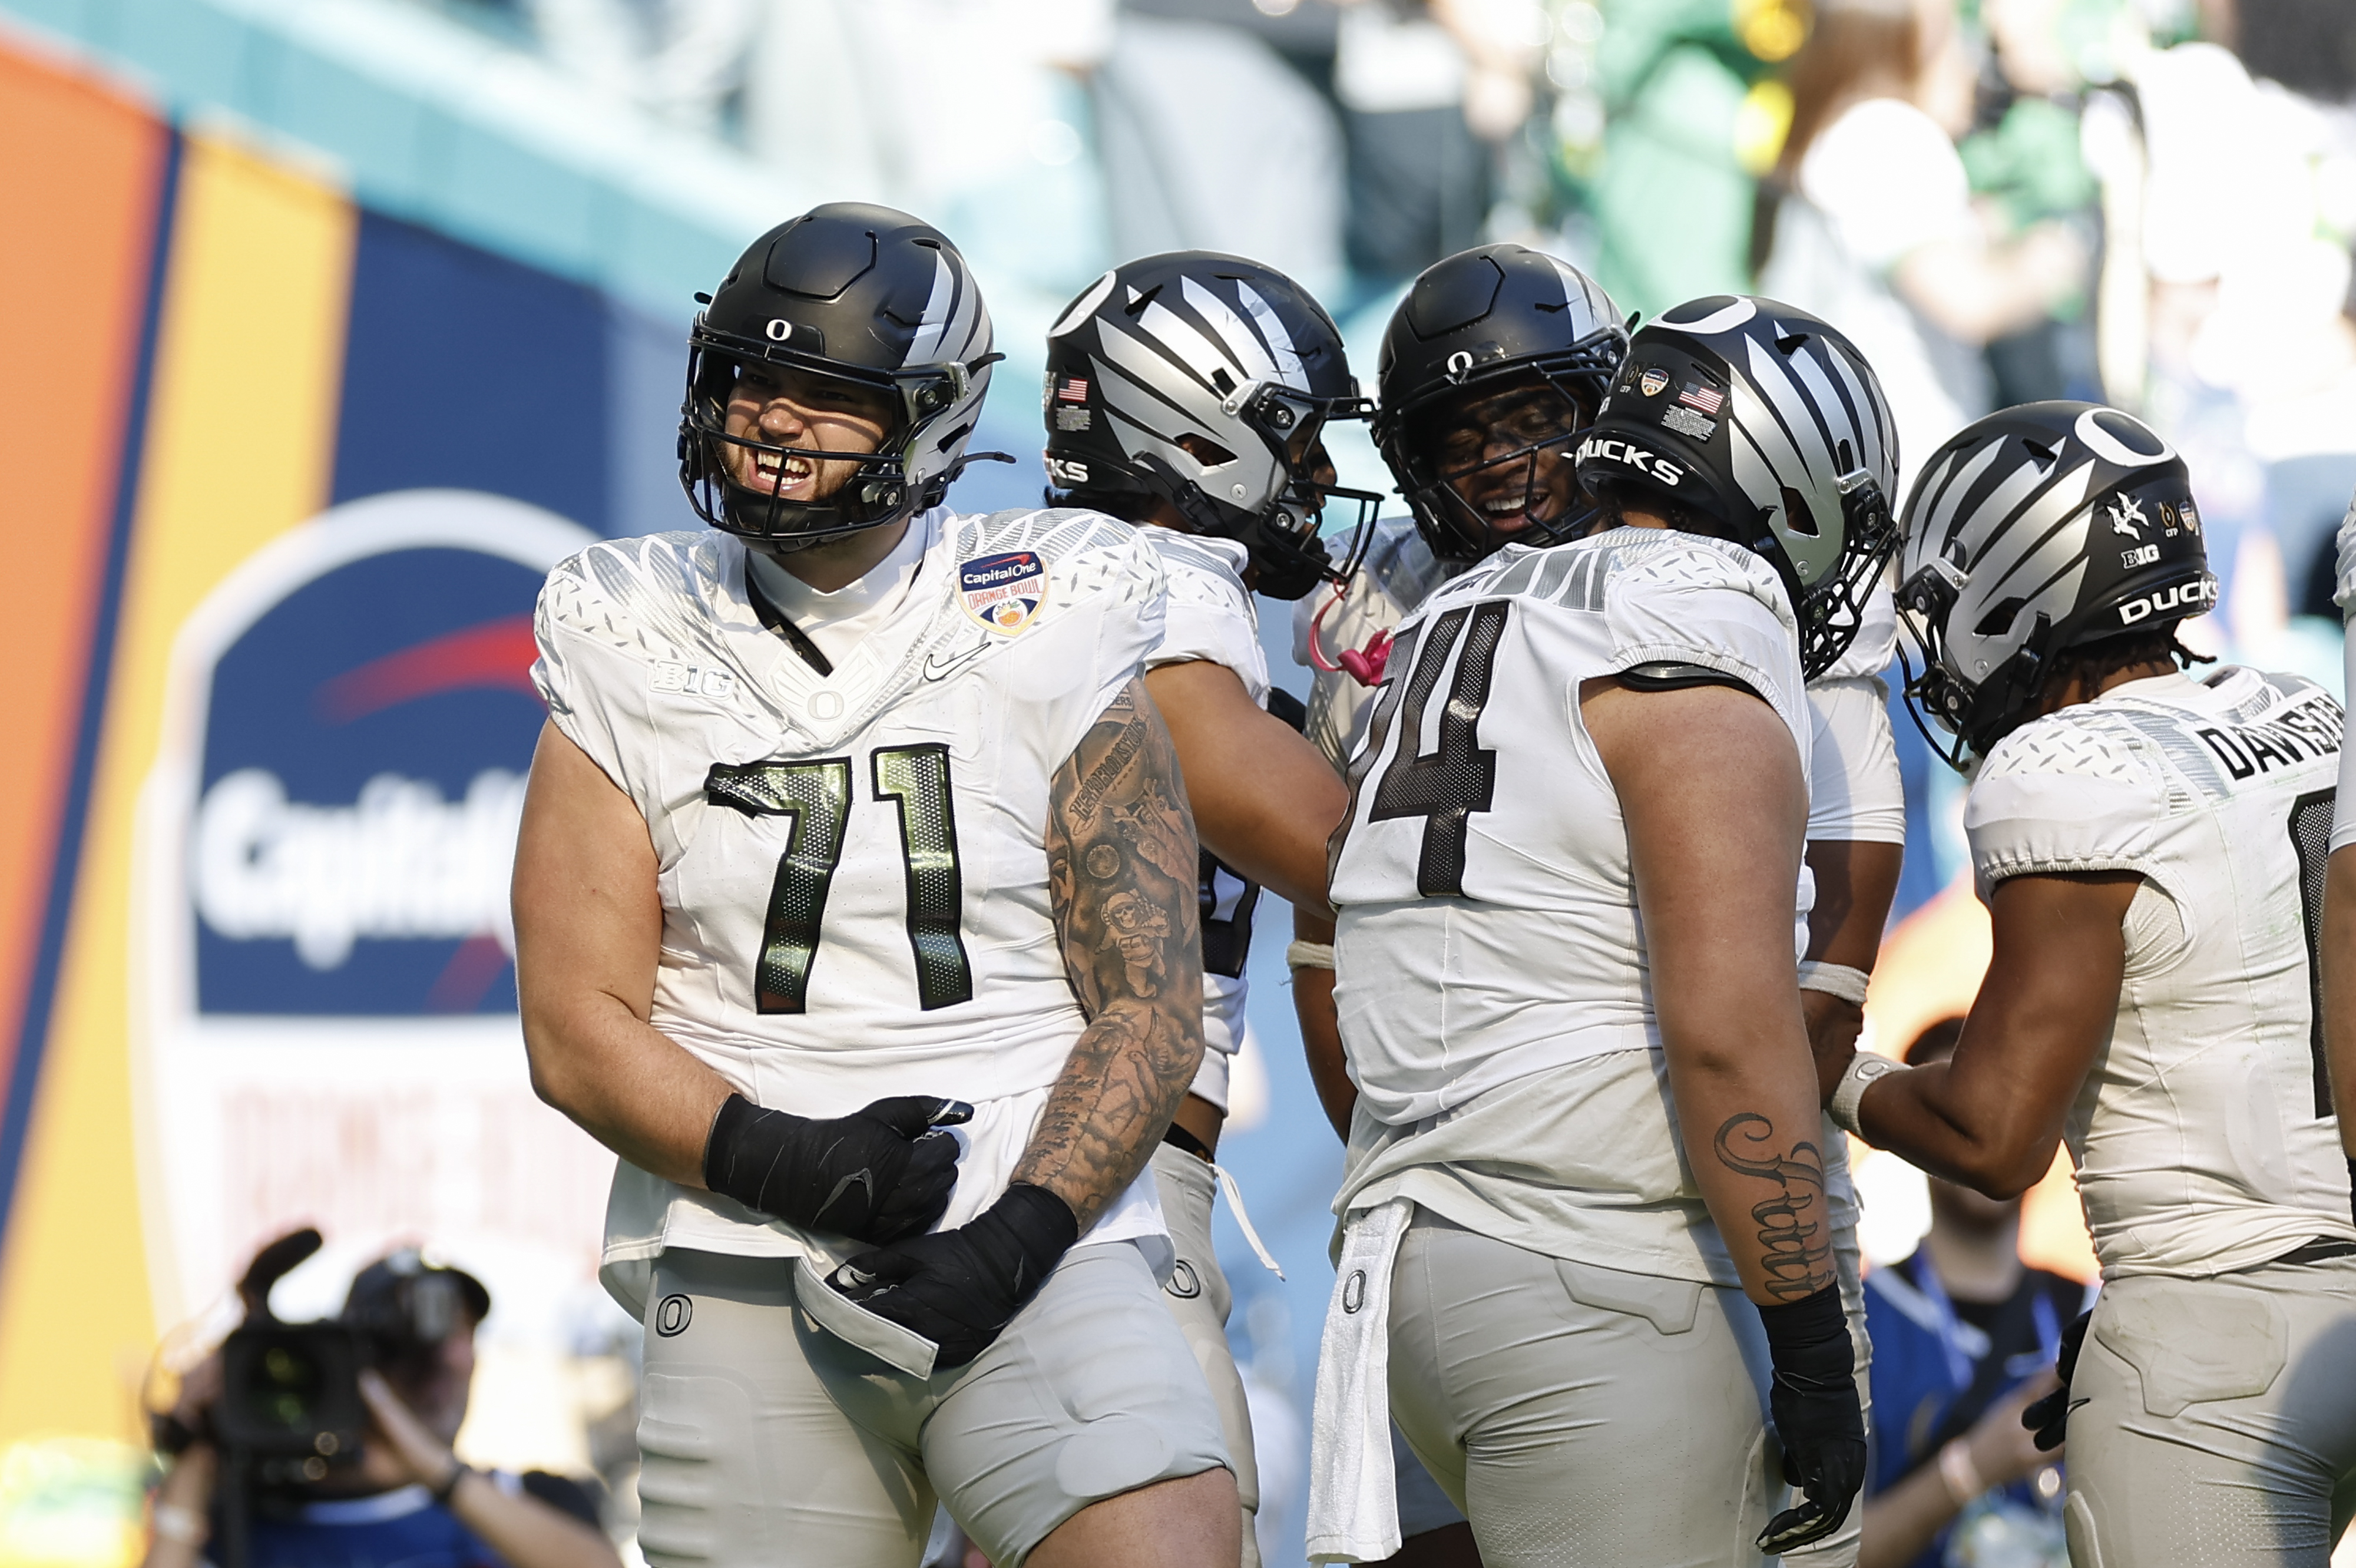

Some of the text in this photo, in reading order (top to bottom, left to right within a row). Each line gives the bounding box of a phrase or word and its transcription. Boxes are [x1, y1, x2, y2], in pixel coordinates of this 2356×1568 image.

[766, 319, 792, 340] O
[1576, 439, 1684, 486] DUCKS
[967, 577, 1043, 610] ORANGE BOWL
[704, 742, 973, 1015] 71
